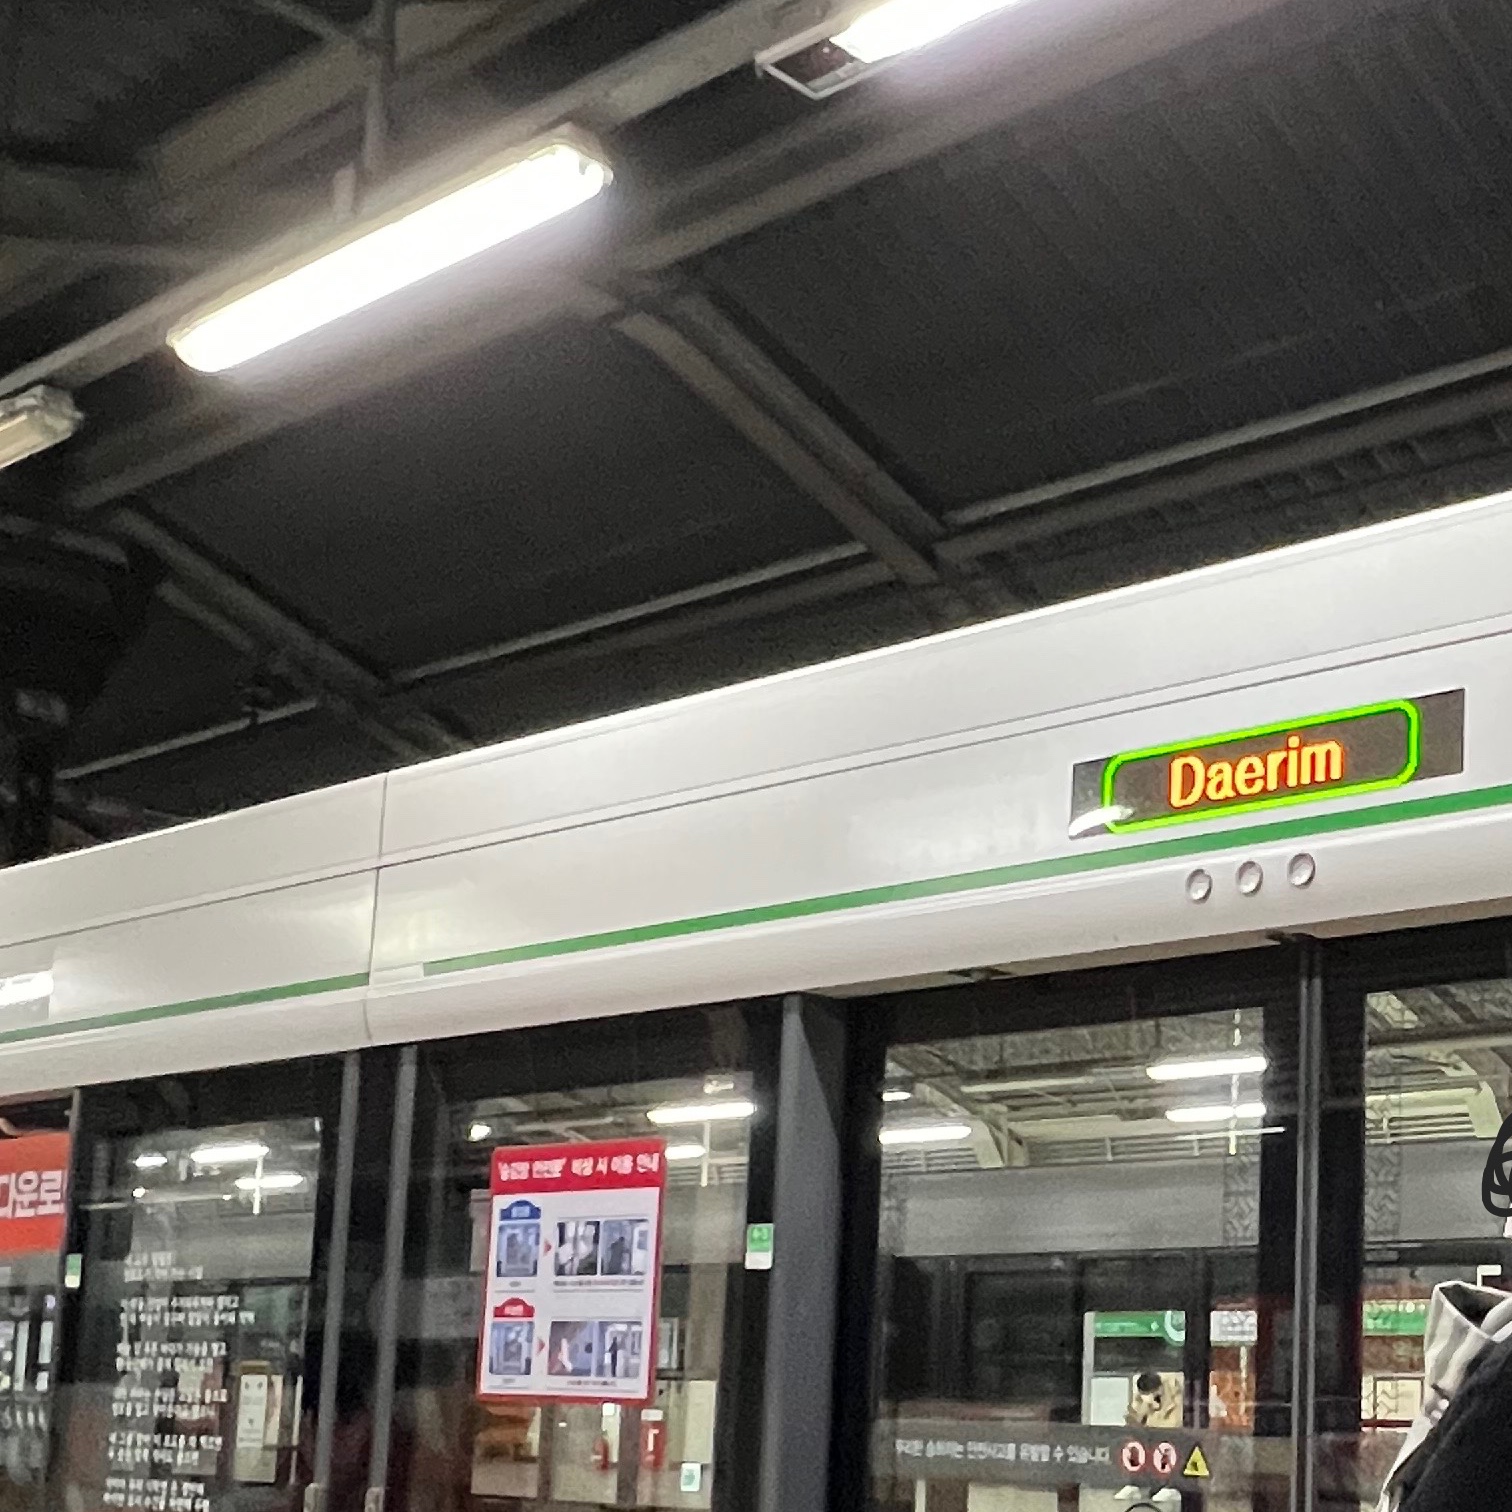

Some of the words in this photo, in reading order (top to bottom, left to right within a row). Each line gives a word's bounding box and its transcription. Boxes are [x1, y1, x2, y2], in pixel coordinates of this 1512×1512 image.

[1169, 733, 1344, 809] Daerim
[0, 1170, 66, 1218] 다운로
[1053, 1445, 1064, 1462] 수
